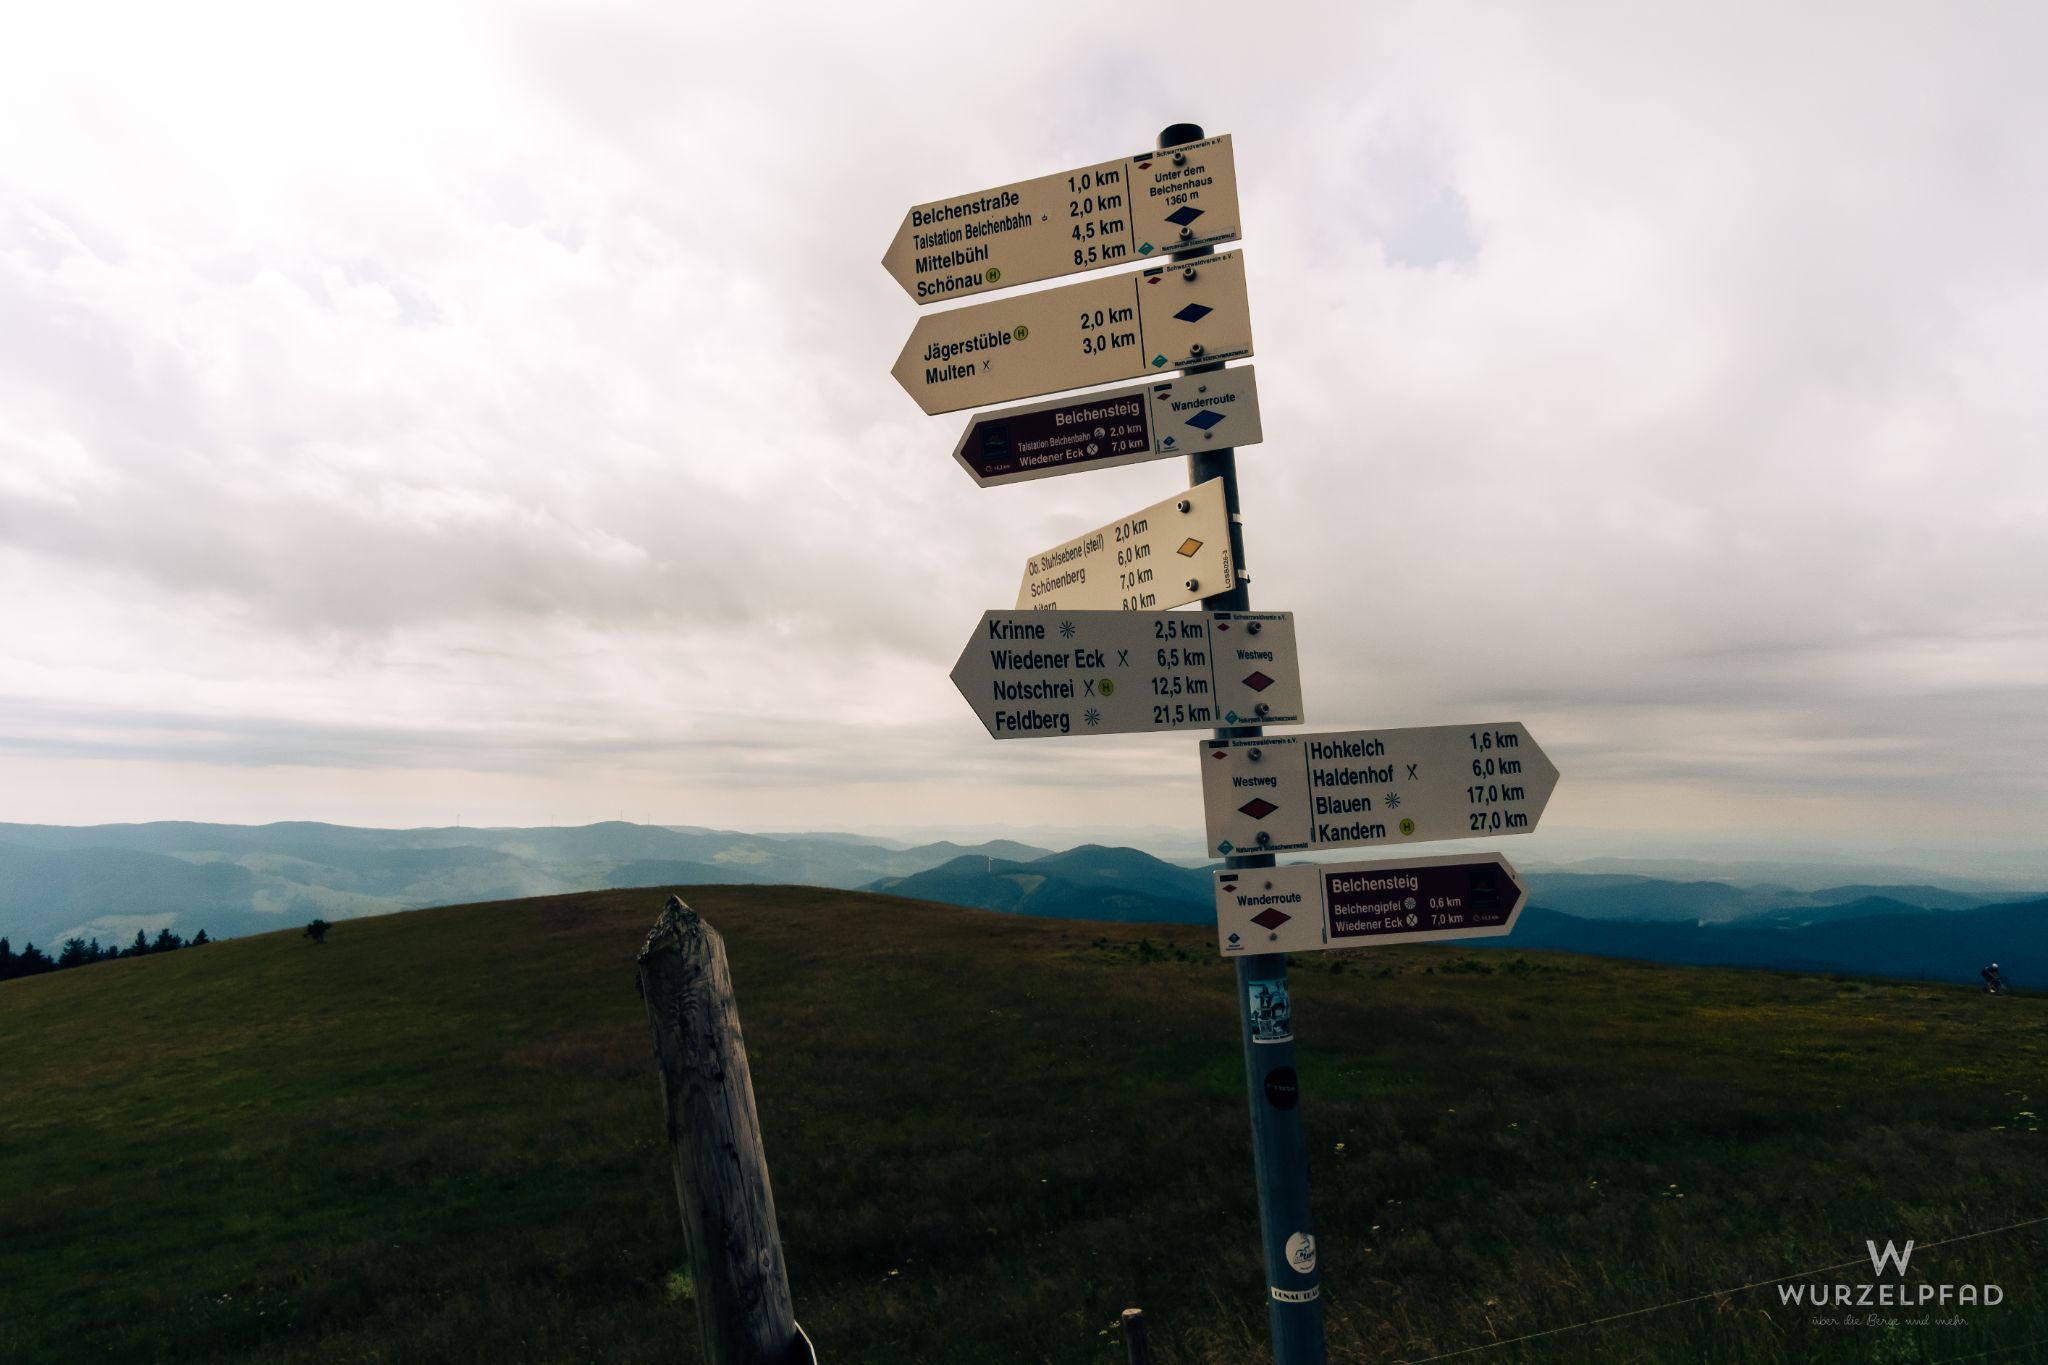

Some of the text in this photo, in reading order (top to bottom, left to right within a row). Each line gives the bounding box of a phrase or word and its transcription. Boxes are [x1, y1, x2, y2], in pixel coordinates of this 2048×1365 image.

[1155, 165, 1205, 182] Unter dem
[912, 168, 1120, 227] Belchenstraße 1,0 km
[1150, 176, 1213, 196] Belchenhaus
[1166, 191, 1199, 206] 1360 m
[914, 194, 1122, 250] Talstation Belchenbahn 2,0 km
[916, 218, 1124, 274] Mittelbühl 4,5 km
[917, 272, 982, 298] Schönau
[1074, 248, 1097, 268] 8,5
[1102, 242, 1126, 261] km
[924, 331, 1012, 362] Jägerstüble
[1080, 312, 1104, 330] 2,0
[1109, 306, 1133, 324] km
[926, 331, 1135, 385] Multen 3,0 km
[1056, 402, 1140, 426] Belchensteig
[1171, 393, 1236, 411] Wanderroute
[1018, 423, 1142, 452] Talstation Belchenbahn 2,0 km
[1020, 452, 1064, 467] Wiedener
[1066, 448, 1084, 460] Eck
[1112, 440, 1124, 453] 7,0
[1128, 438, 1143, 449] km
[1029, 562, 1040, 576] Ob.
[1084, 534, 1104, 558] (steil)
[1116, 523, 1130, 544] 2,0
[1132, 519, 1148, 534] km
[1031, 544, 1150, 598] Schönenberg 6,0 km
[1120, 568, 1153, 591] 7,0 km
[1140, 594, 1156, 608] km
[989, 620, 1203, 641] Krinne 2,5 km
[991, 648, 1206, 670] Wiedener Eck 6,5 km
[1237, 650, 1273, 662] Westweg
[993, 679, 1074, 700] Notschrei
[1152, 677, 1182, 698] 12,5
[1186, 676, 1208, 694] km
[996, 704, 1210, 733] Feldberg 21,5 km
[1311, 730, 1518, 760] Hohkelch 1,6 km
[1232, 776, 1277, 789] Westweg
[1313, 757, 1521, 787] Haldenhof 6,0 km
[1316, 783, 1524, 815] Blauen 17,0 km
[1319, 822, 1386, 843] Kandern
[1470, 812, 1500, 832] 27,0
[1505, 810, 1528, 828] km
[1332, 875, 1418, 894] Belchensteig
[1237, 893, 1302, 907] Wanderroute
[1334, 896, 1462, 918] Belchengipfel 0,6 km
[1336, 913, 1464, 932] Wiedener Eck 7,0 km
